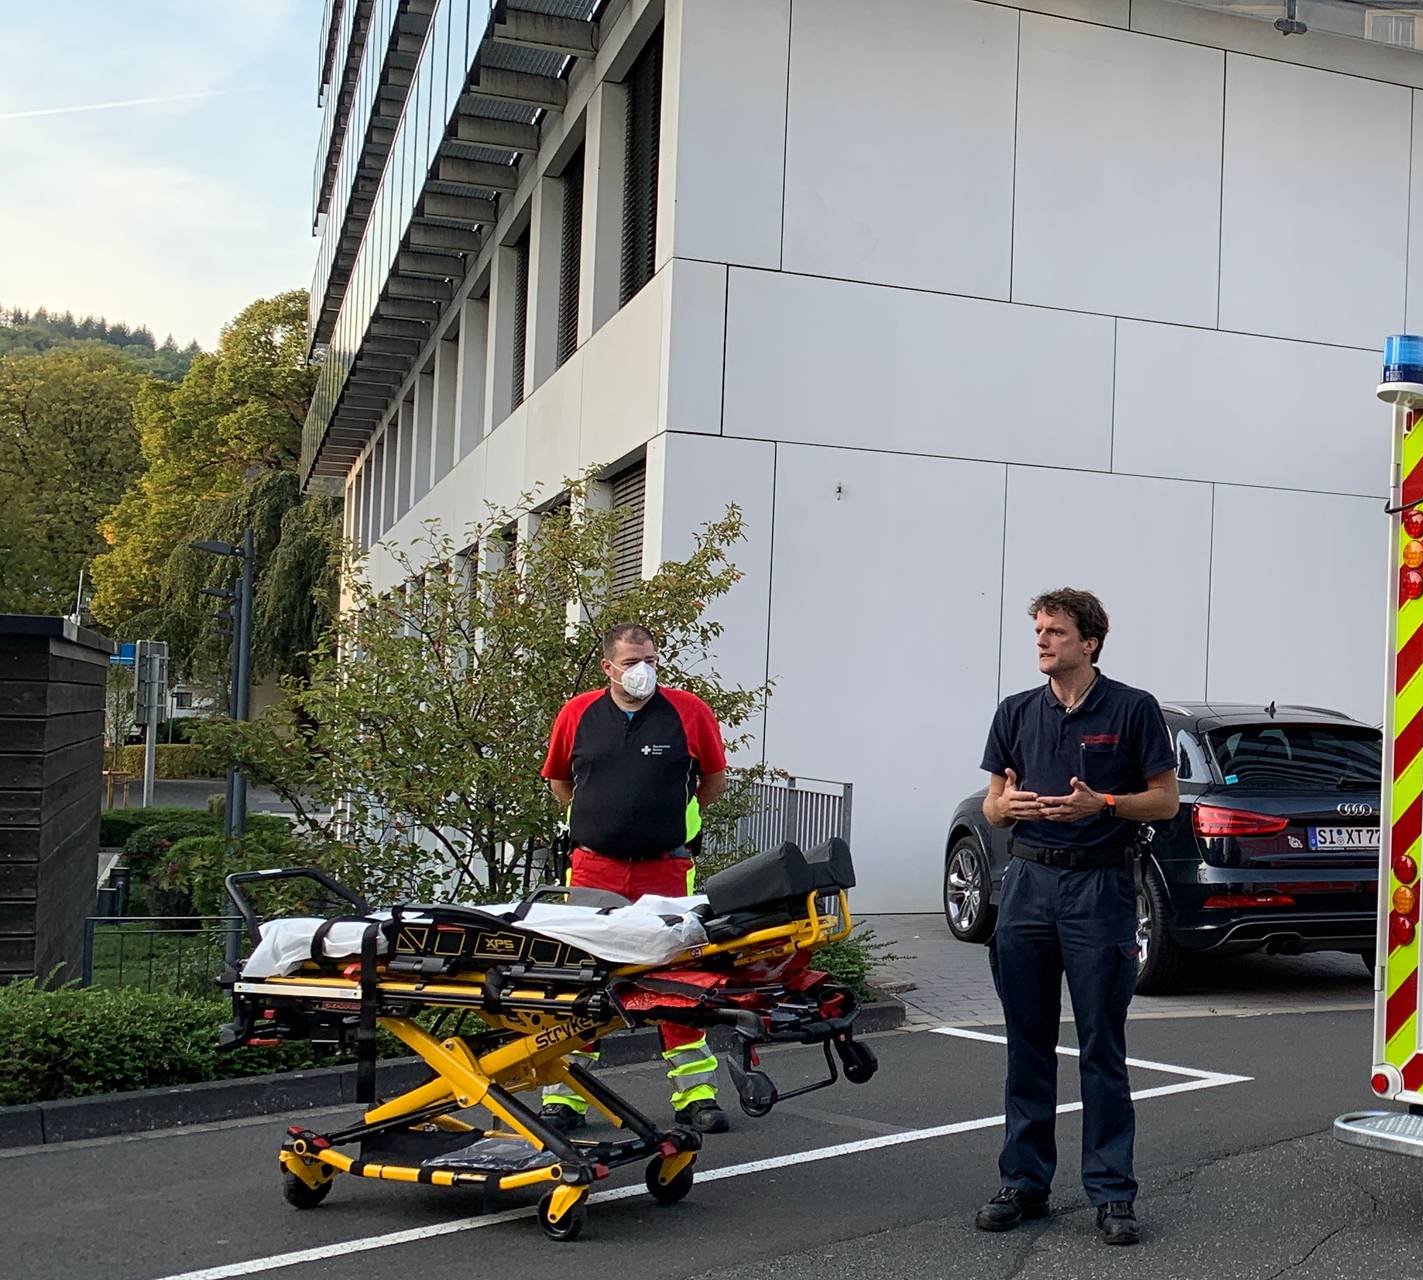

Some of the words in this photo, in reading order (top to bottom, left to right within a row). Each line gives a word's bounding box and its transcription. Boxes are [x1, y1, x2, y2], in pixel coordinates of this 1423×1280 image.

[1318, 829, 1336, 845] SI
[1345, 829, 1363, 844] XT
[485, 938, 514, 949] XPS
[535, 1015, 594, 1050] stryke
